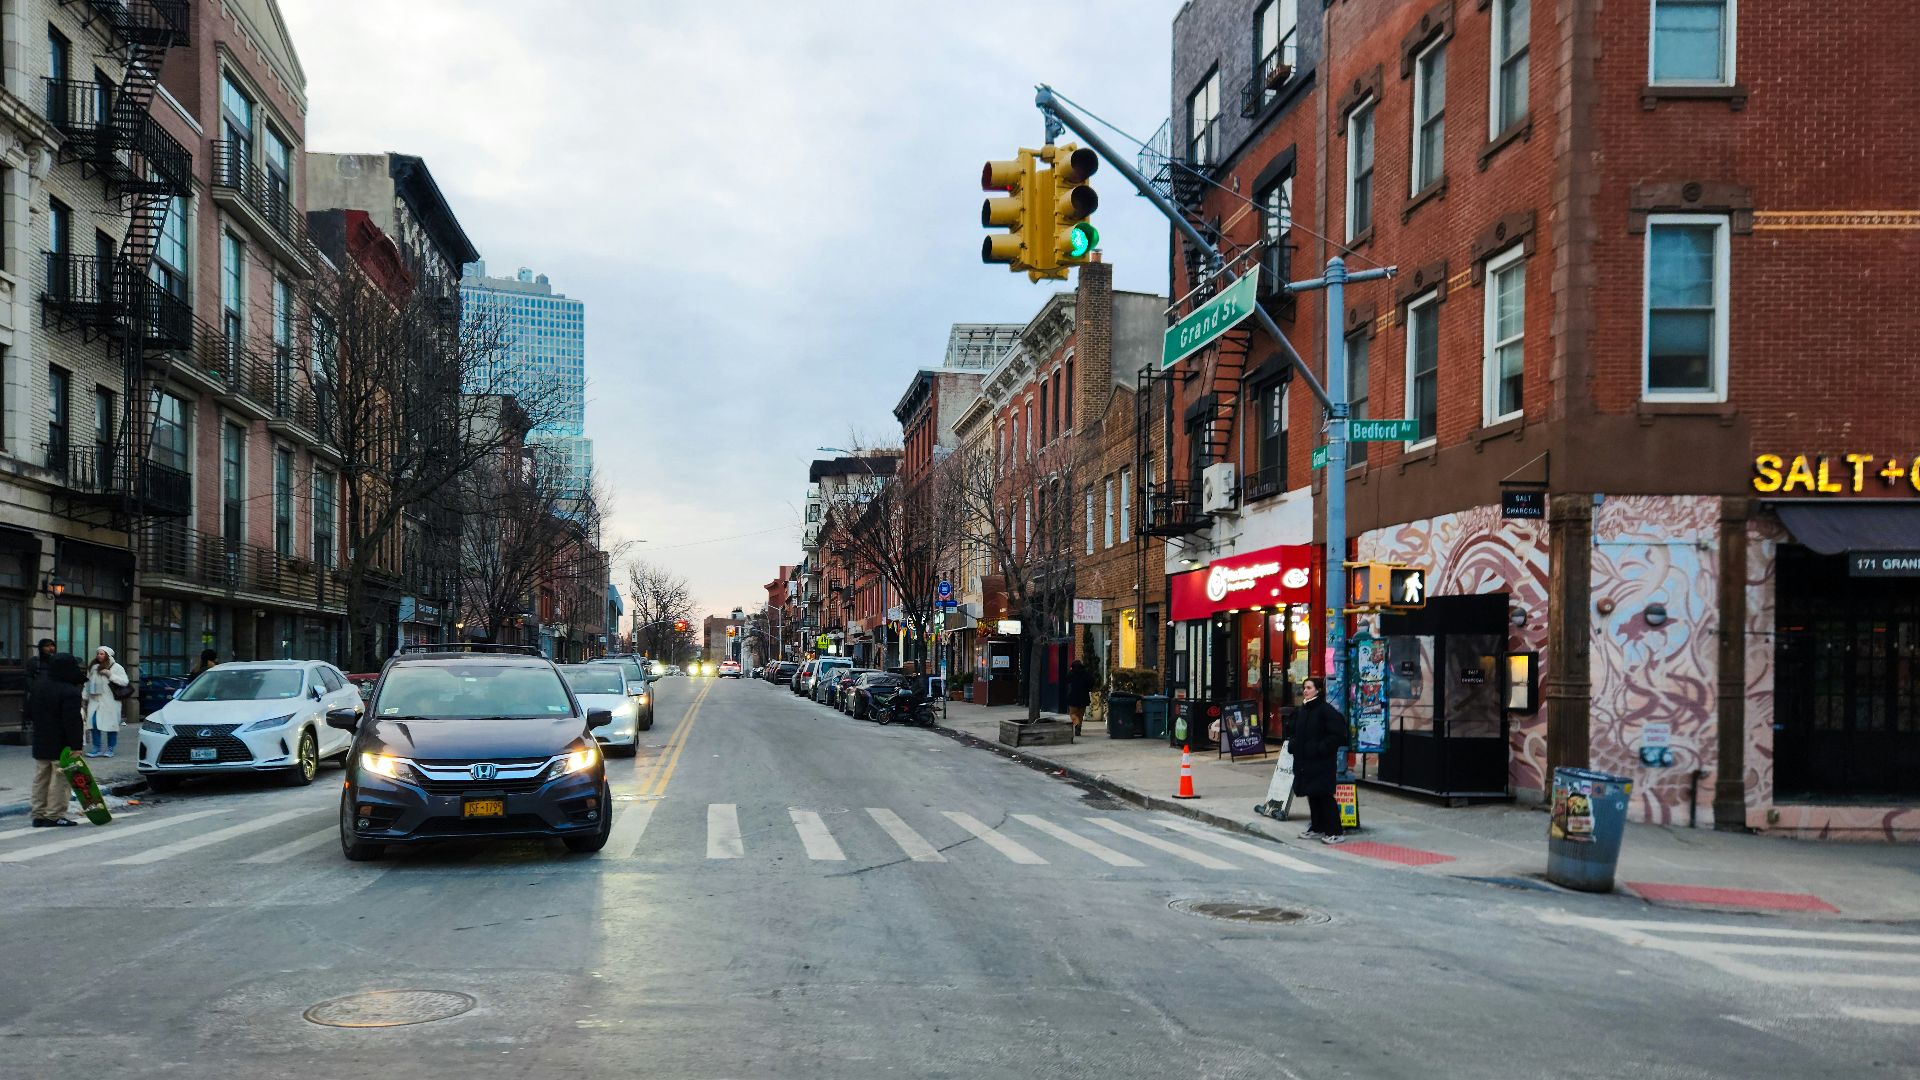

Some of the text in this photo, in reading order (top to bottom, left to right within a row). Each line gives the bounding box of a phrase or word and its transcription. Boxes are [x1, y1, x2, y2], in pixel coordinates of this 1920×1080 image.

[1180, 292, 1237, 349] Grand St
[1353, 421, 1411, 439] Bedford Av
[1313, 448, 1326, 467] Grand
[1752, 453, 1874, 493] SALT
[1515, 494, 1532, 502] SALT
[1506, 507, 1541, 515] CHARCOAL
[1857, 558, 1876, 570] 171
